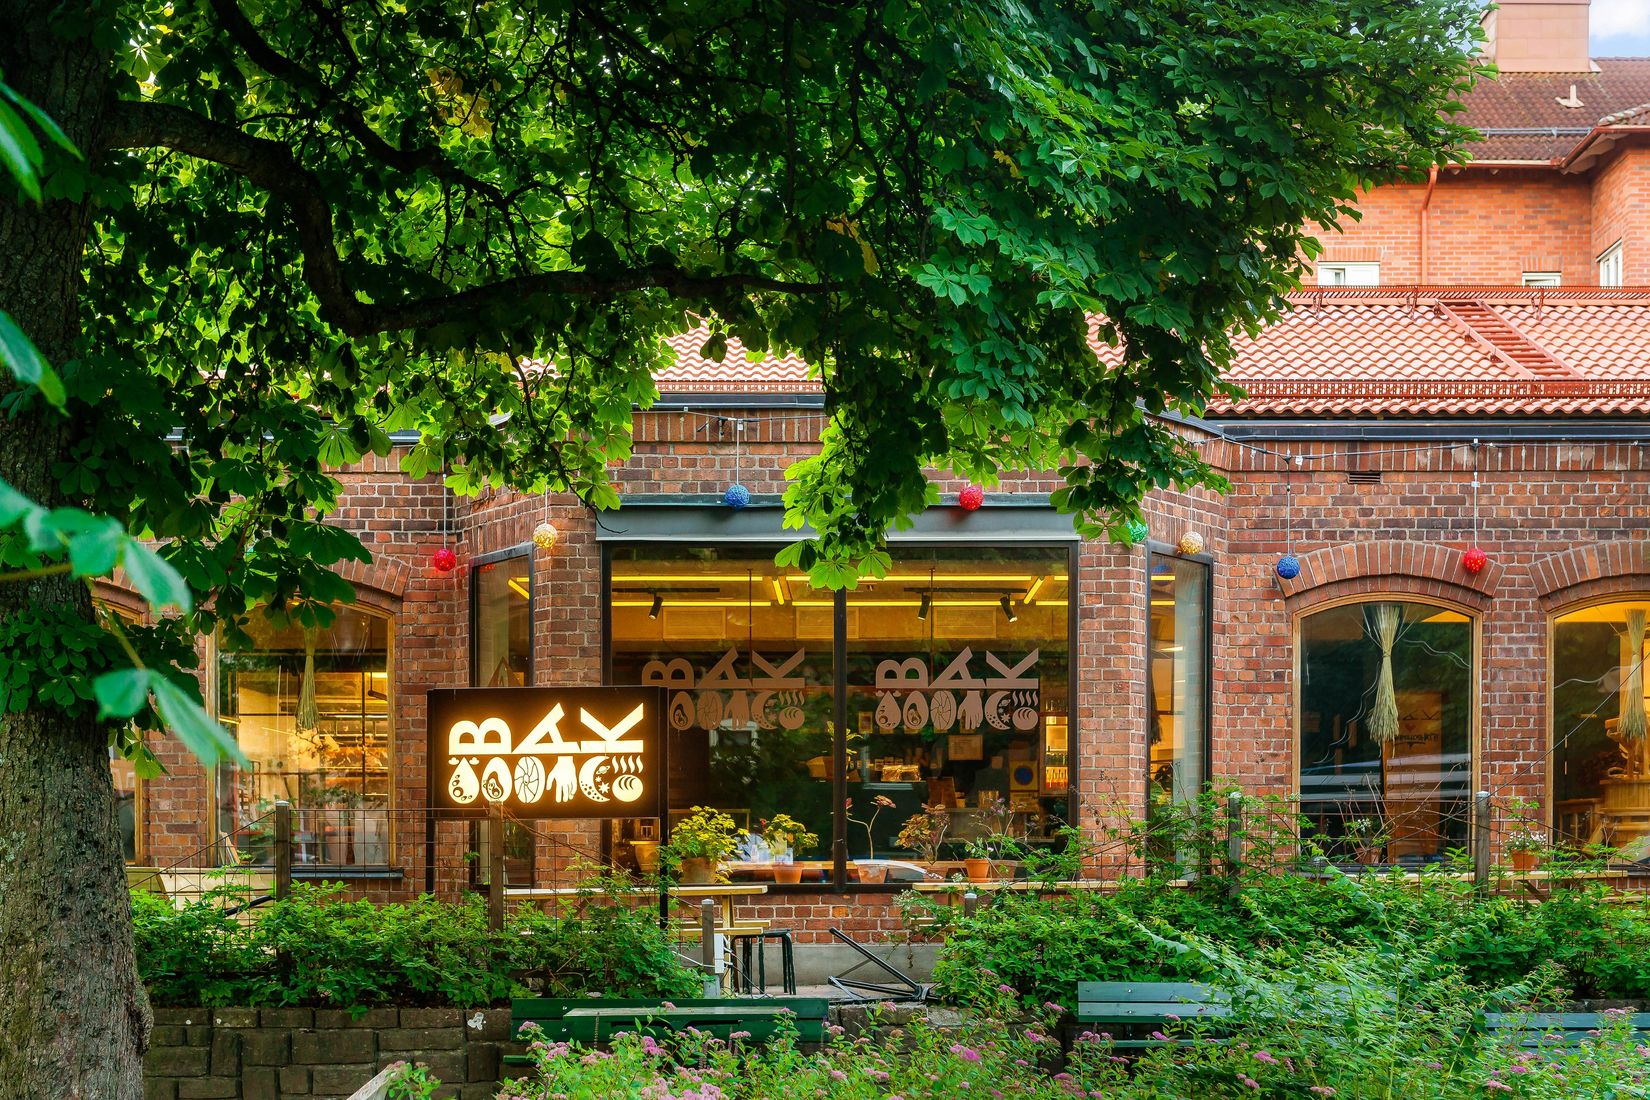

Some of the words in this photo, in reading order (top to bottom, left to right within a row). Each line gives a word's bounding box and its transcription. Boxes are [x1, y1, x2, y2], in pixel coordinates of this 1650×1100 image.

[641, 647, 805, 689] BAK
[875, 645, 1039, 689] BAK
[448, 702, 644, 755] BAK
